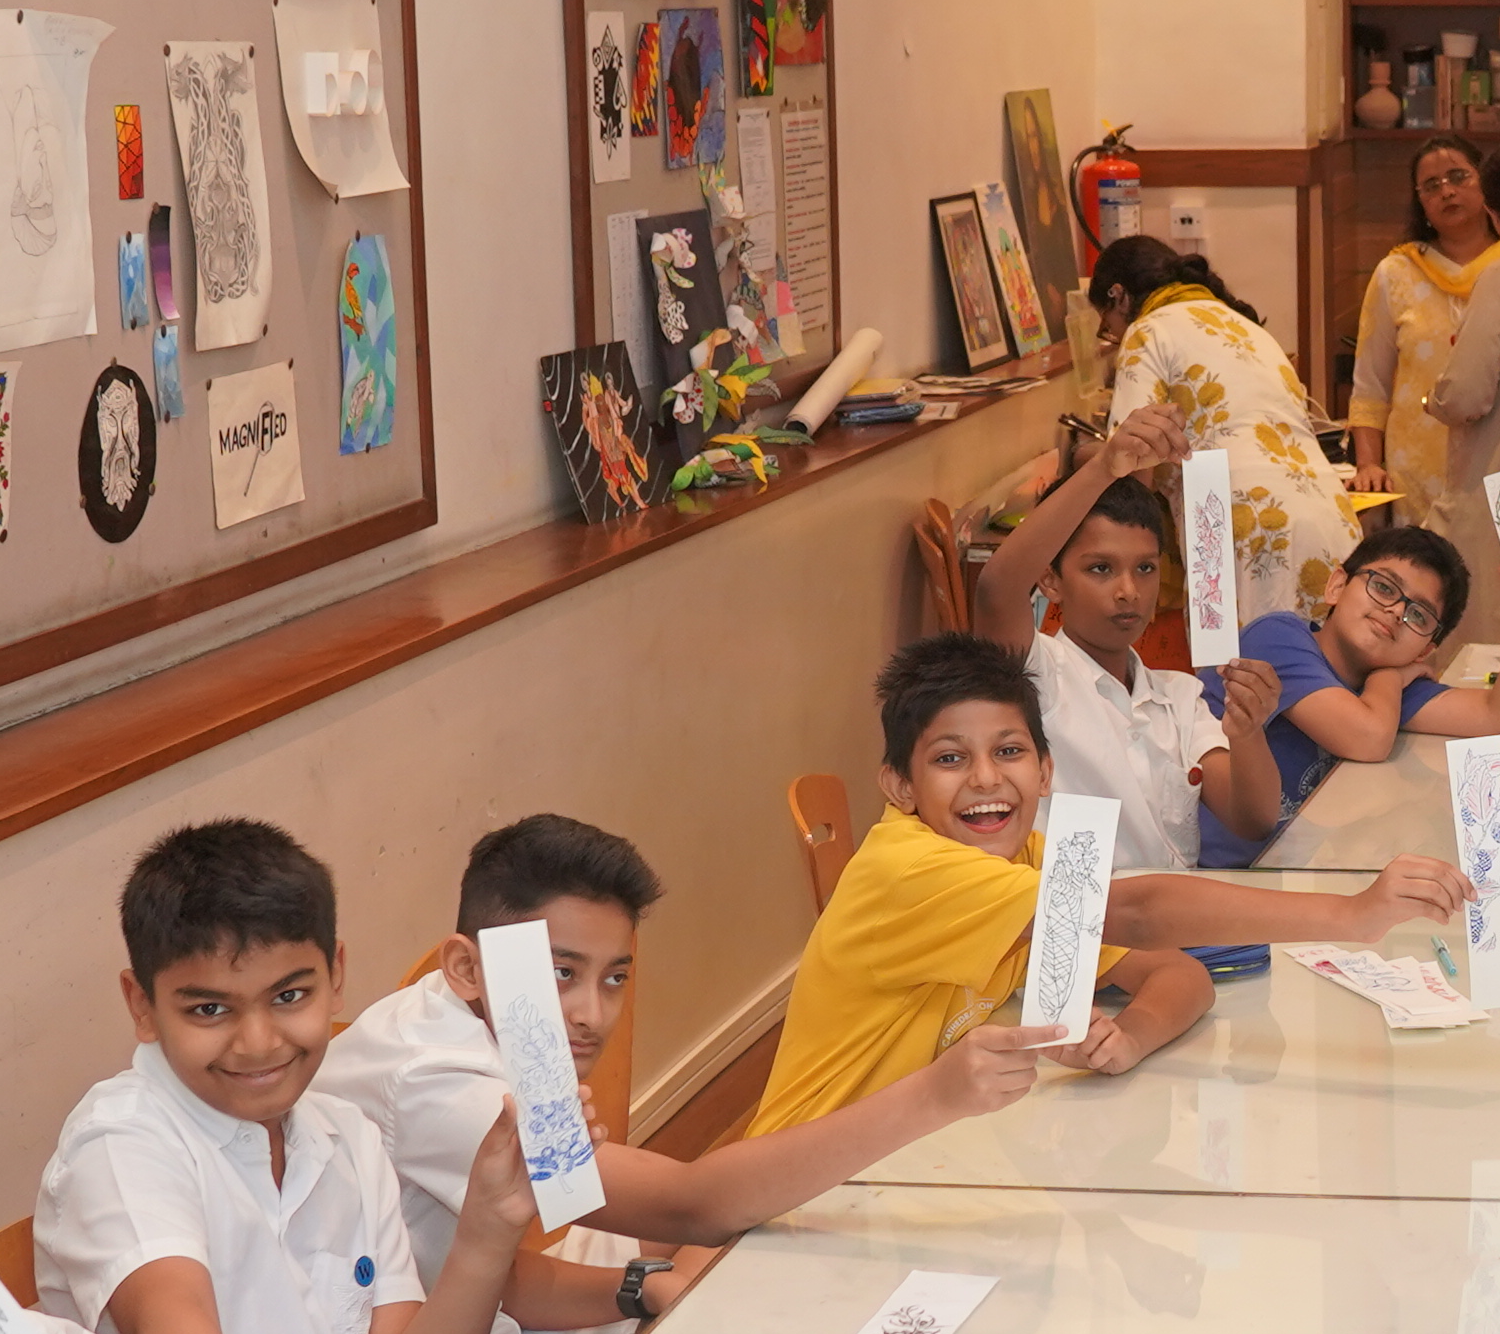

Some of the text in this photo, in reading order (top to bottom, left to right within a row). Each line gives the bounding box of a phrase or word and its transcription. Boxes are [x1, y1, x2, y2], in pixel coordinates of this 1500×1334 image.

[218, 410, 287, 456] MAGNIFIED
[941, 1009, 974, 1047] CATHEDR
[357, 1261, 371, 1280] W
